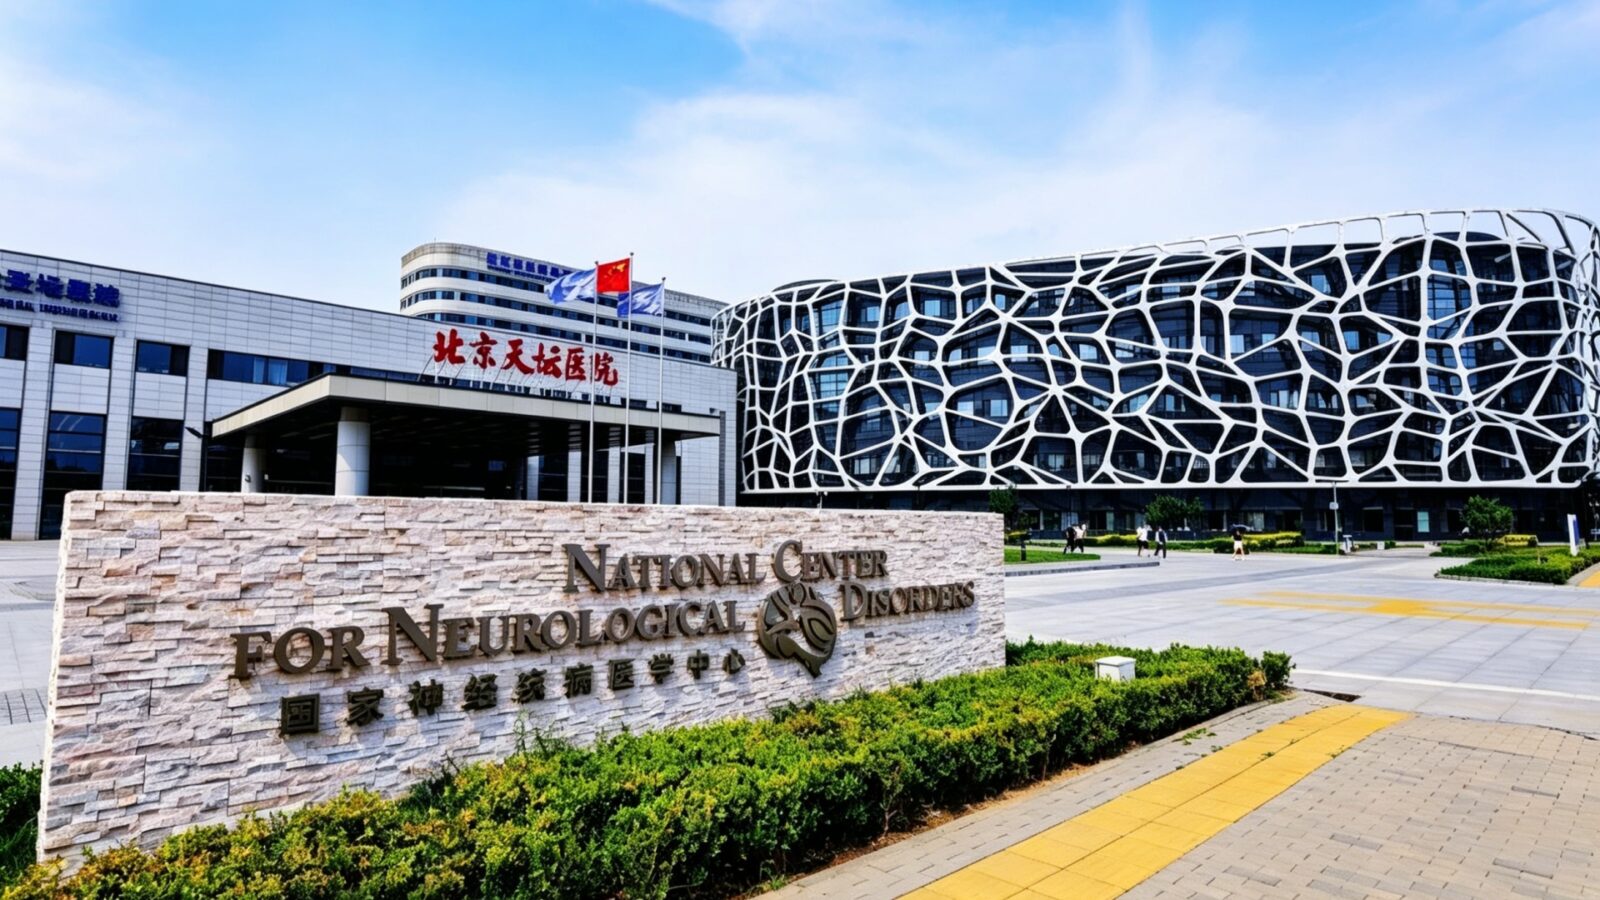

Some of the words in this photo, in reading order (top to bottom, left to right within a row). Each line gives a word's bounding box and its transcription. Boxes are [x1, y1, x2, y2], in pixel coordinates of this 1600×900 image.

[433, 328, 619, 386] 北京天坛医院
[563, 543, 765, 592] NATIONAL
[772, 539, 888, 582] CENTER
[234, 627, 370, 679] FOR
[382, 600, 745, 665] NEUROLOGICAL
[840, 581, 975, 621] DISORDERS
